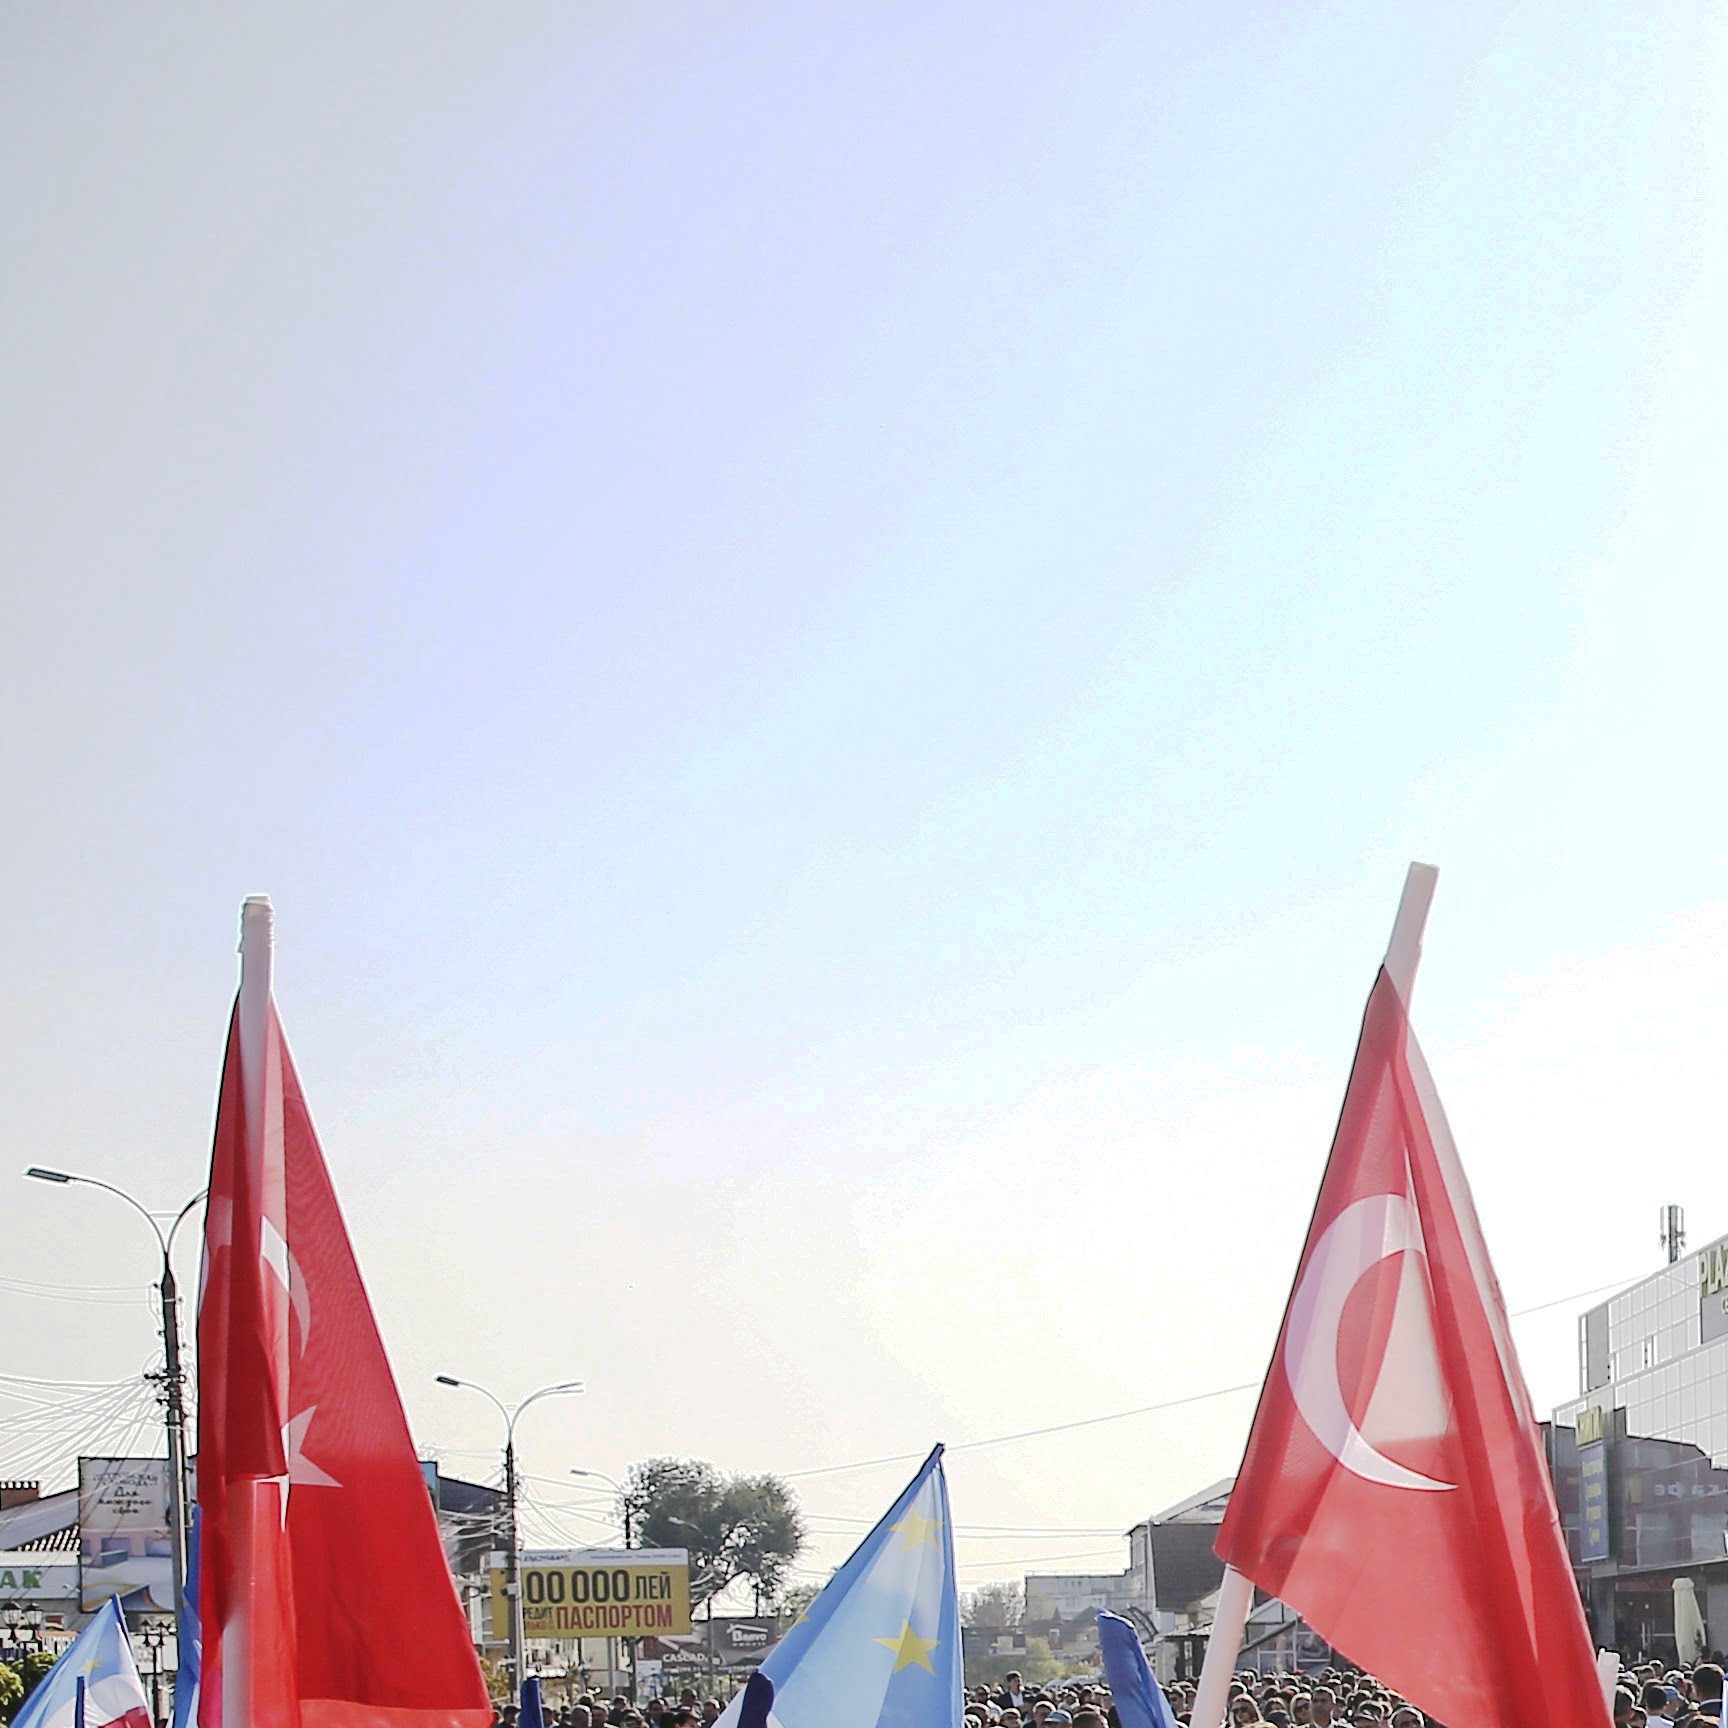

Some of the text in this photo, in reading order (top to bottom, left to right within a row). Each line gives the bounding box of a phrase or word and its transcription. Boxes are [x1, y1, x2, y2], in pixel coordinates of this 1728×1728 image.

[571, 1569, 630, 1603] 000
[634, 1572, 671, 1600] ЛЕЙ
[556, 1604, 673, 1630] ПАСПОРТОМ
